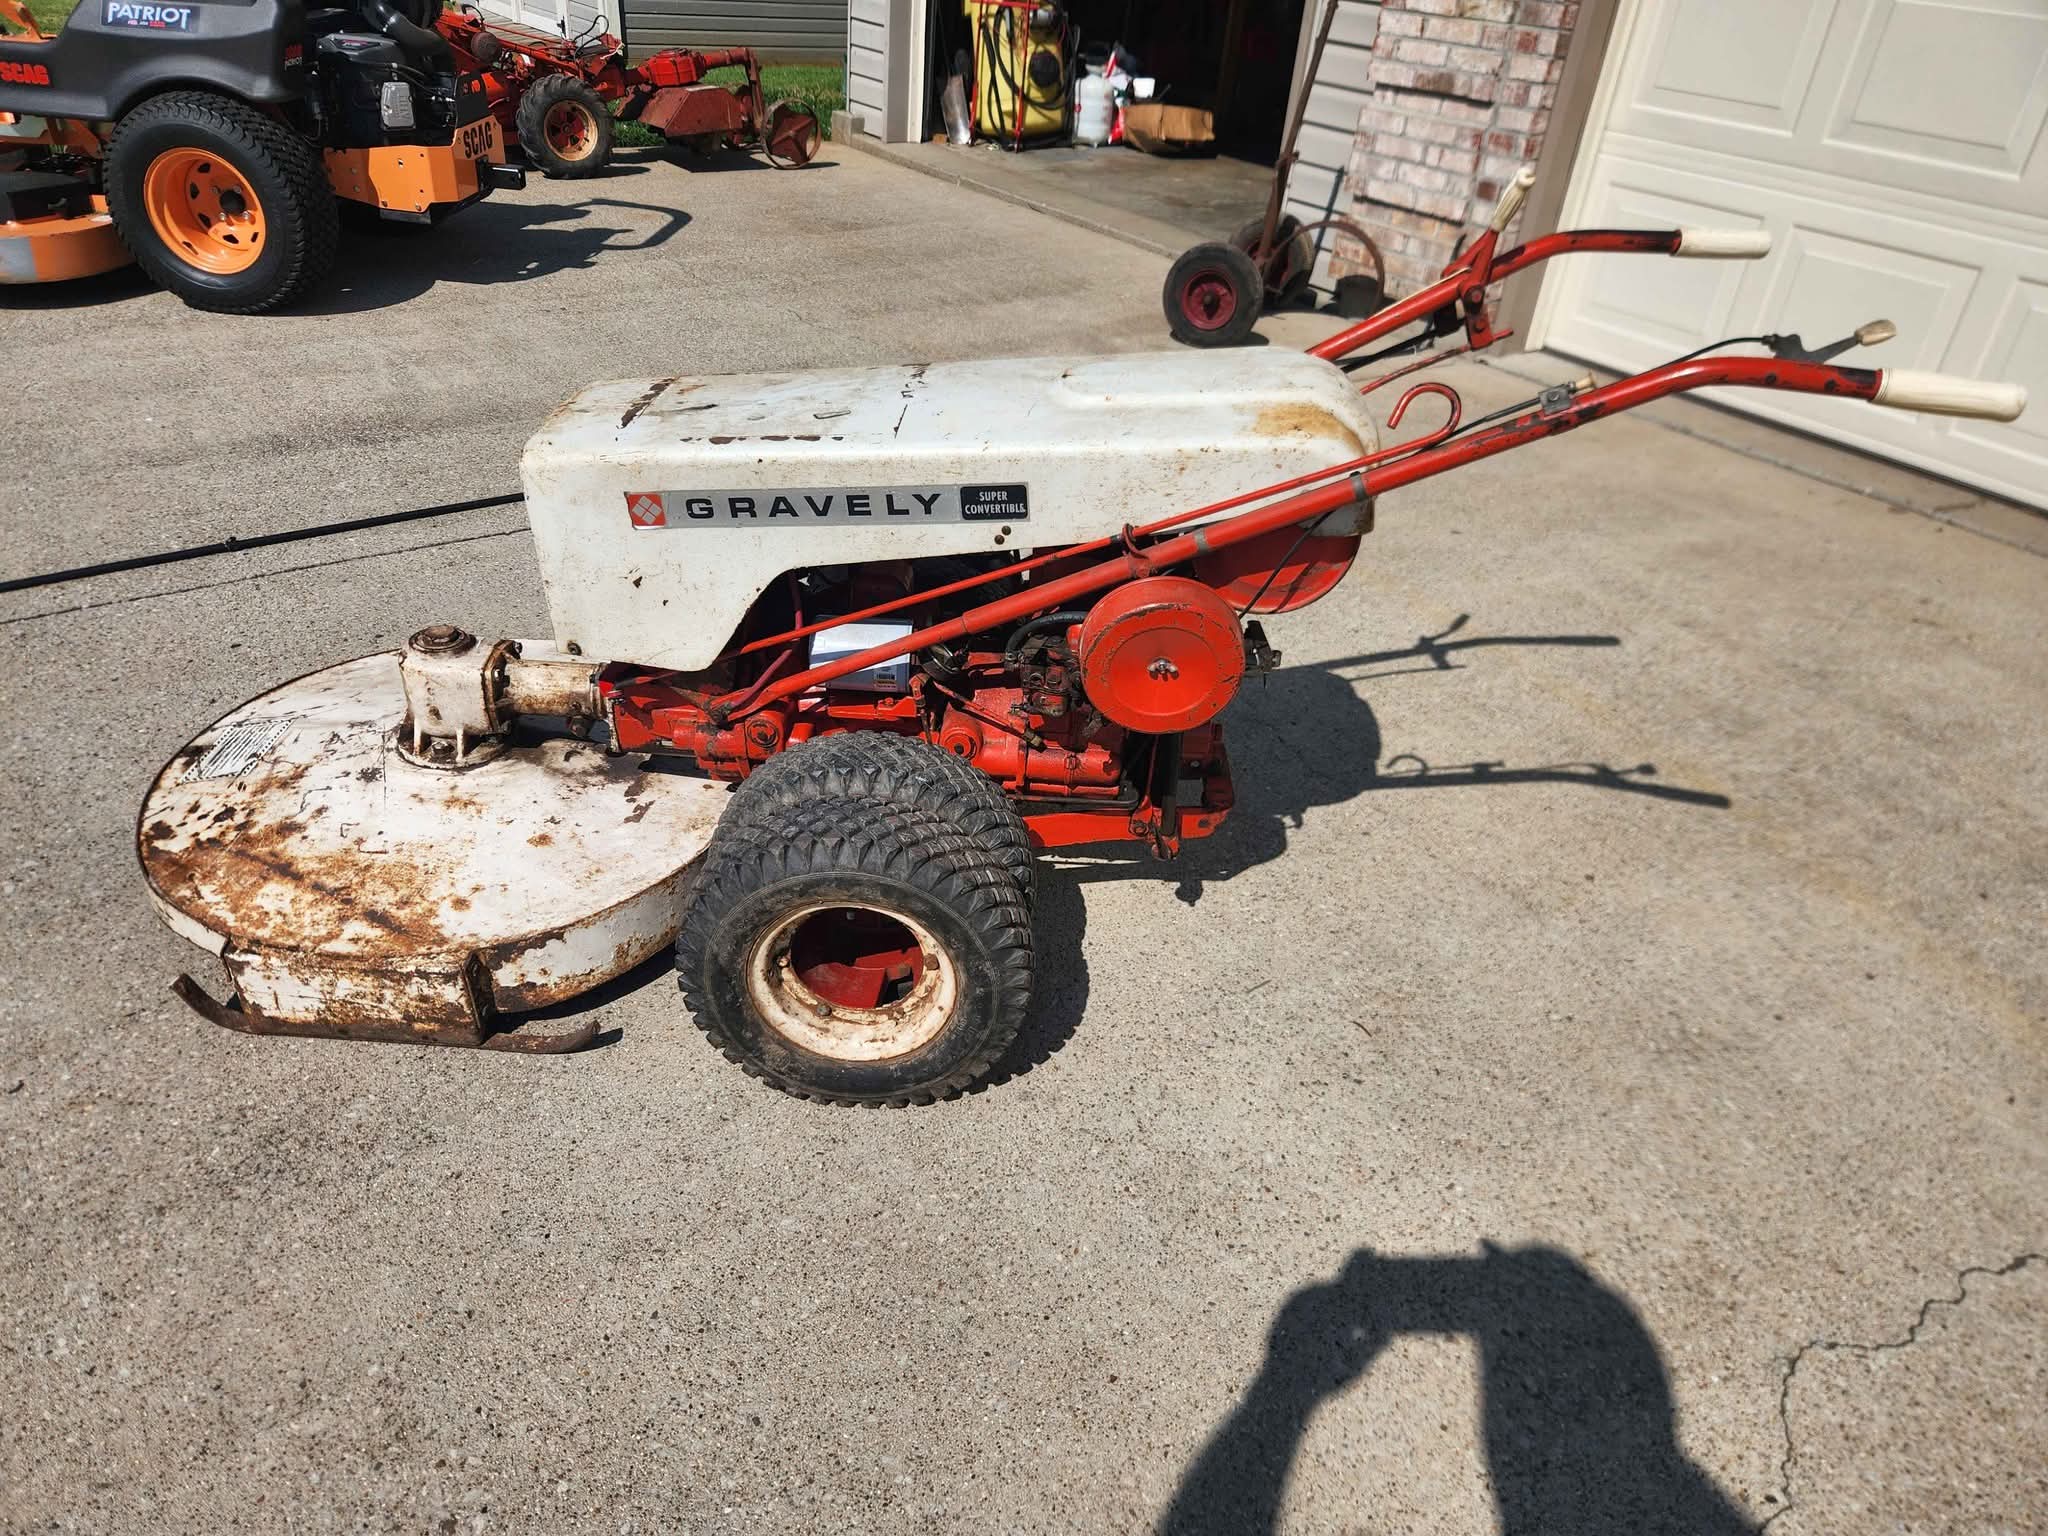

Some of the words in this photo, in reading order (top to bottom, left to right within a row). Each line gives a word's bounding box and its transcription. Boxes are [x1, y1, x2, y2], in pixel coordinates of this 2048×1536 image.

[107, 2, 191, 29] PATRIOT
[0, 62, 49, 85] SCAG
[463, 121, 492, 159] SCAG
[686, 493, 941, 519] GRAVELY
[979, 491, 1008, 501] SUPER
[964, 503, 1026, 514] CONVERTIBLE
